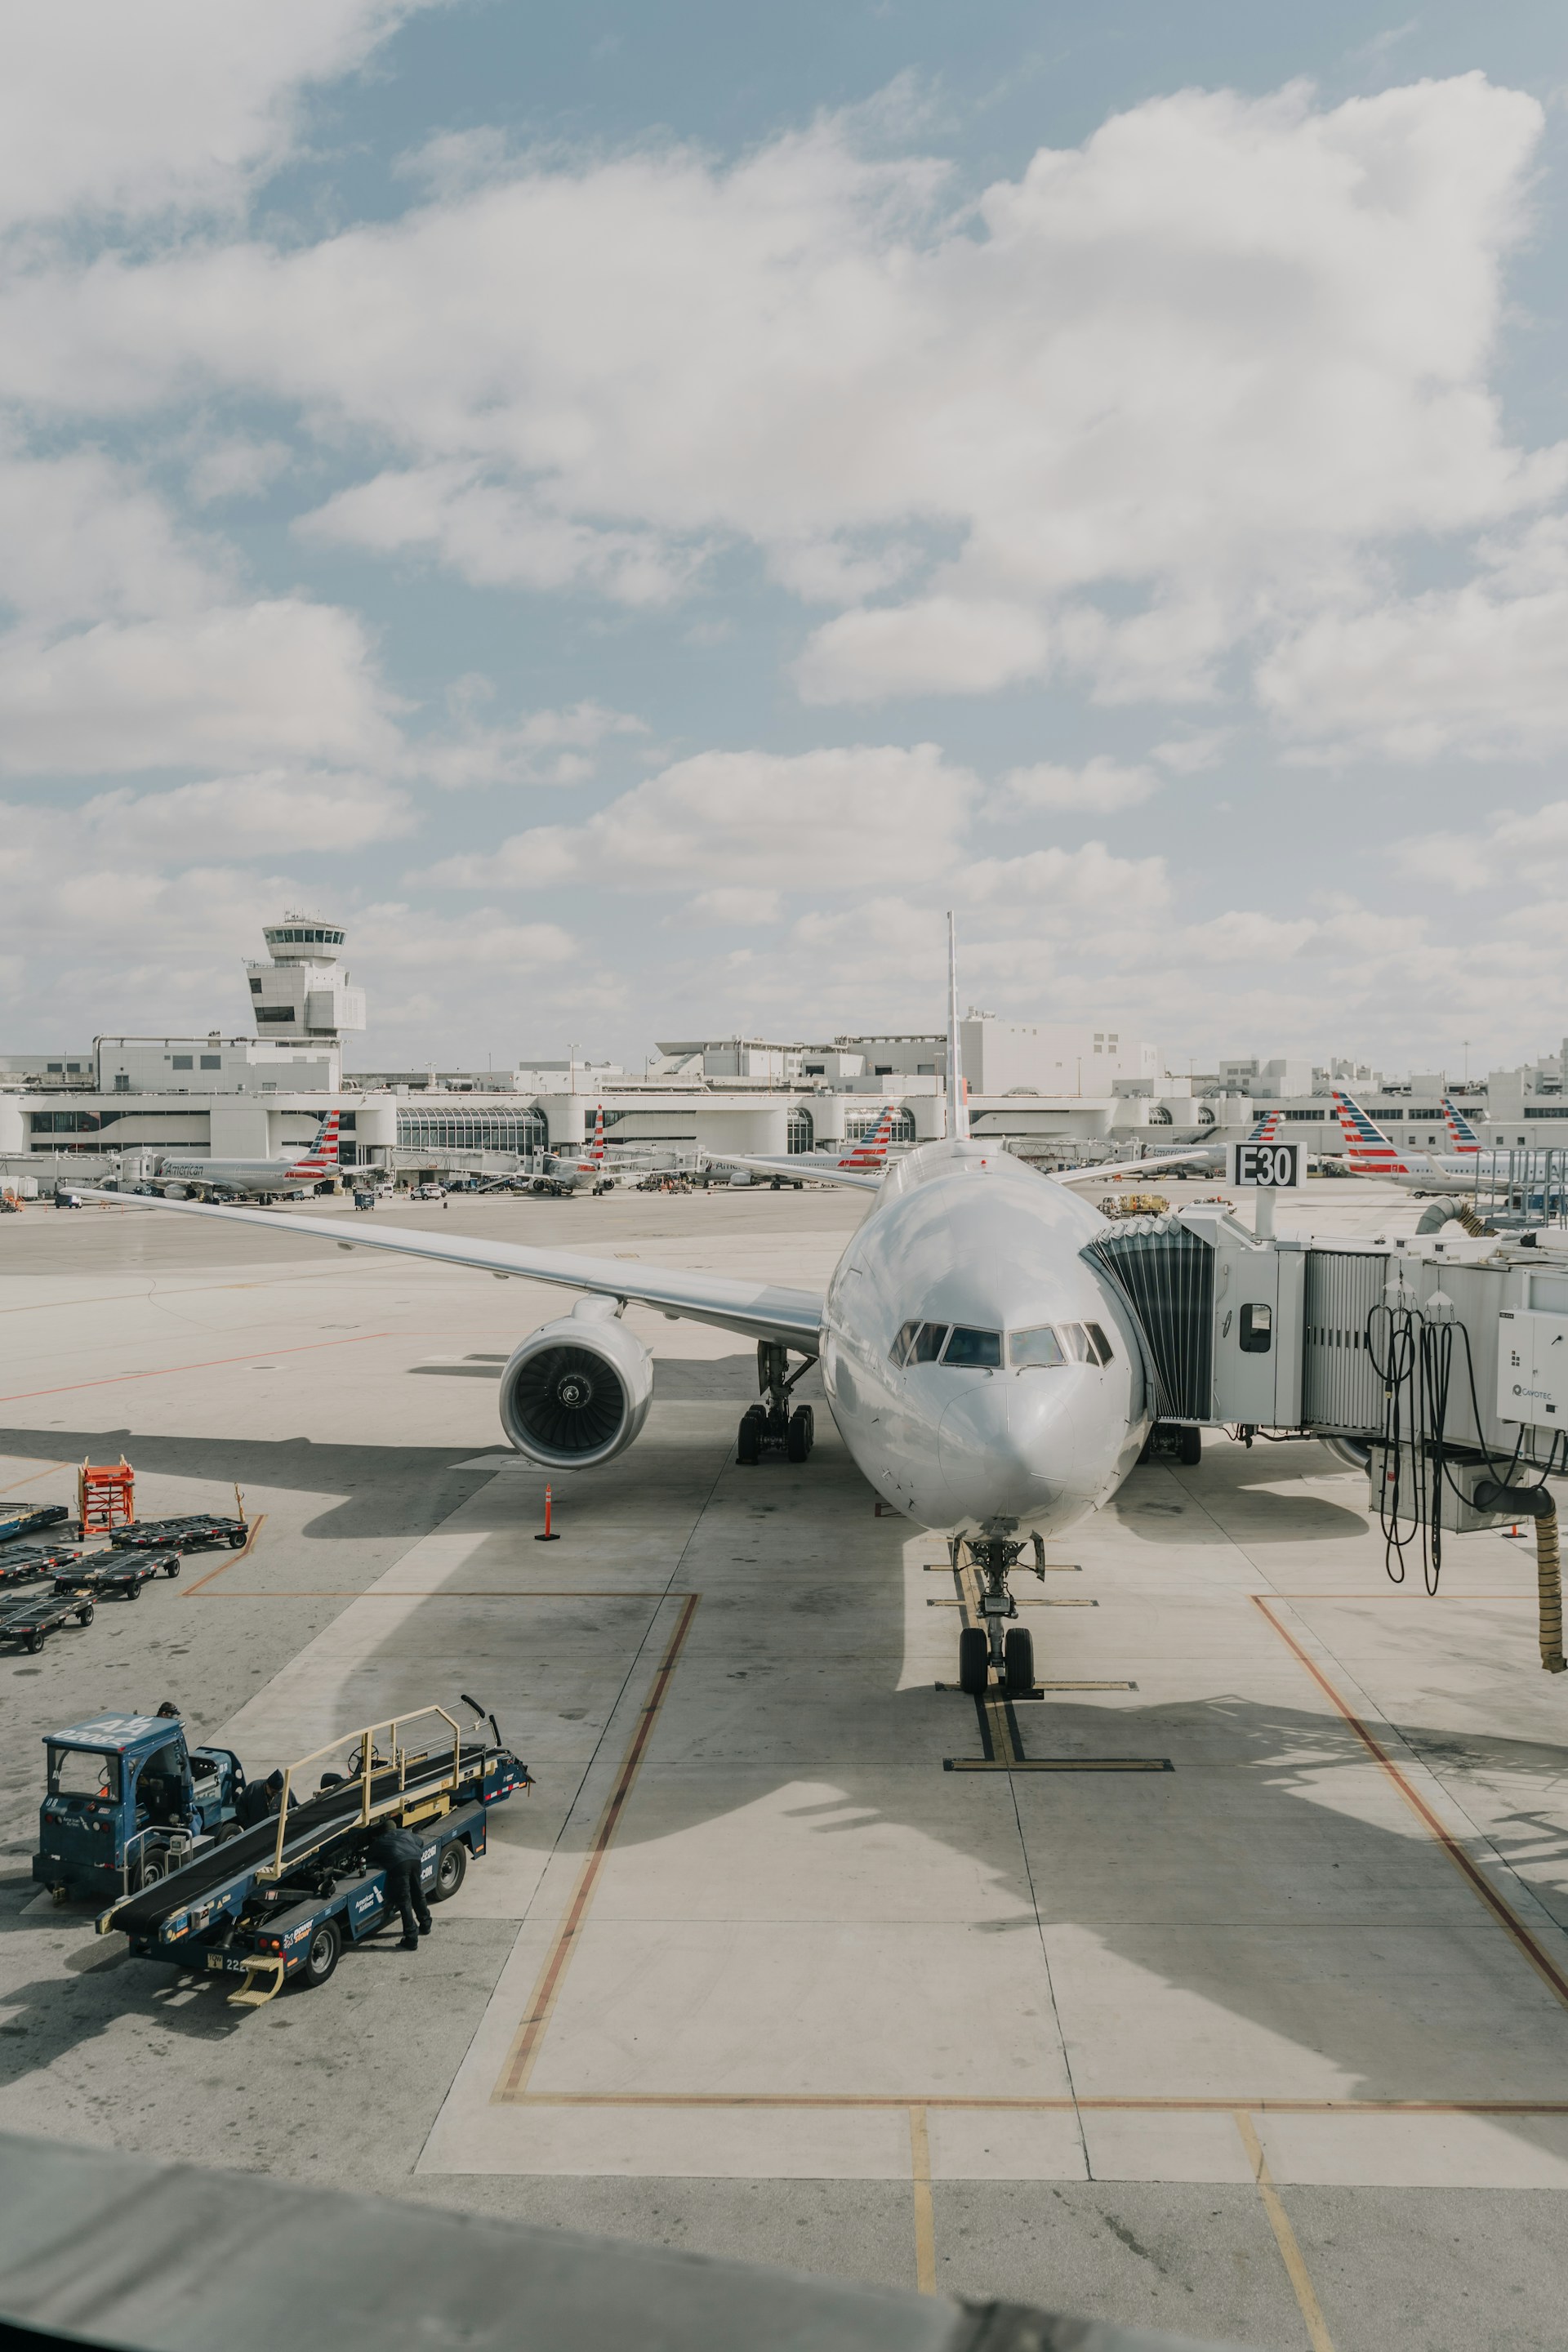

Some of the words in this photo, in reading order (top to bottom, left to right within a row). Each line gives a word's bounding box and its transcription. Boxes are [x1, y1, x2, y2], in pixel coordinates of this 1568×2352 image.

[166, 1163, 203, 1176] American
[1240, 1147, 1292, 1186] E30
[1521, 1388, 1552, 1401] CAVOTEC
[84, 1719, 153, 1736] AA
[355, 1892, 374, 1909] American
[359, 1899, 374, 1913] Airlines
[209, 1953, 222, 1962] TOW
